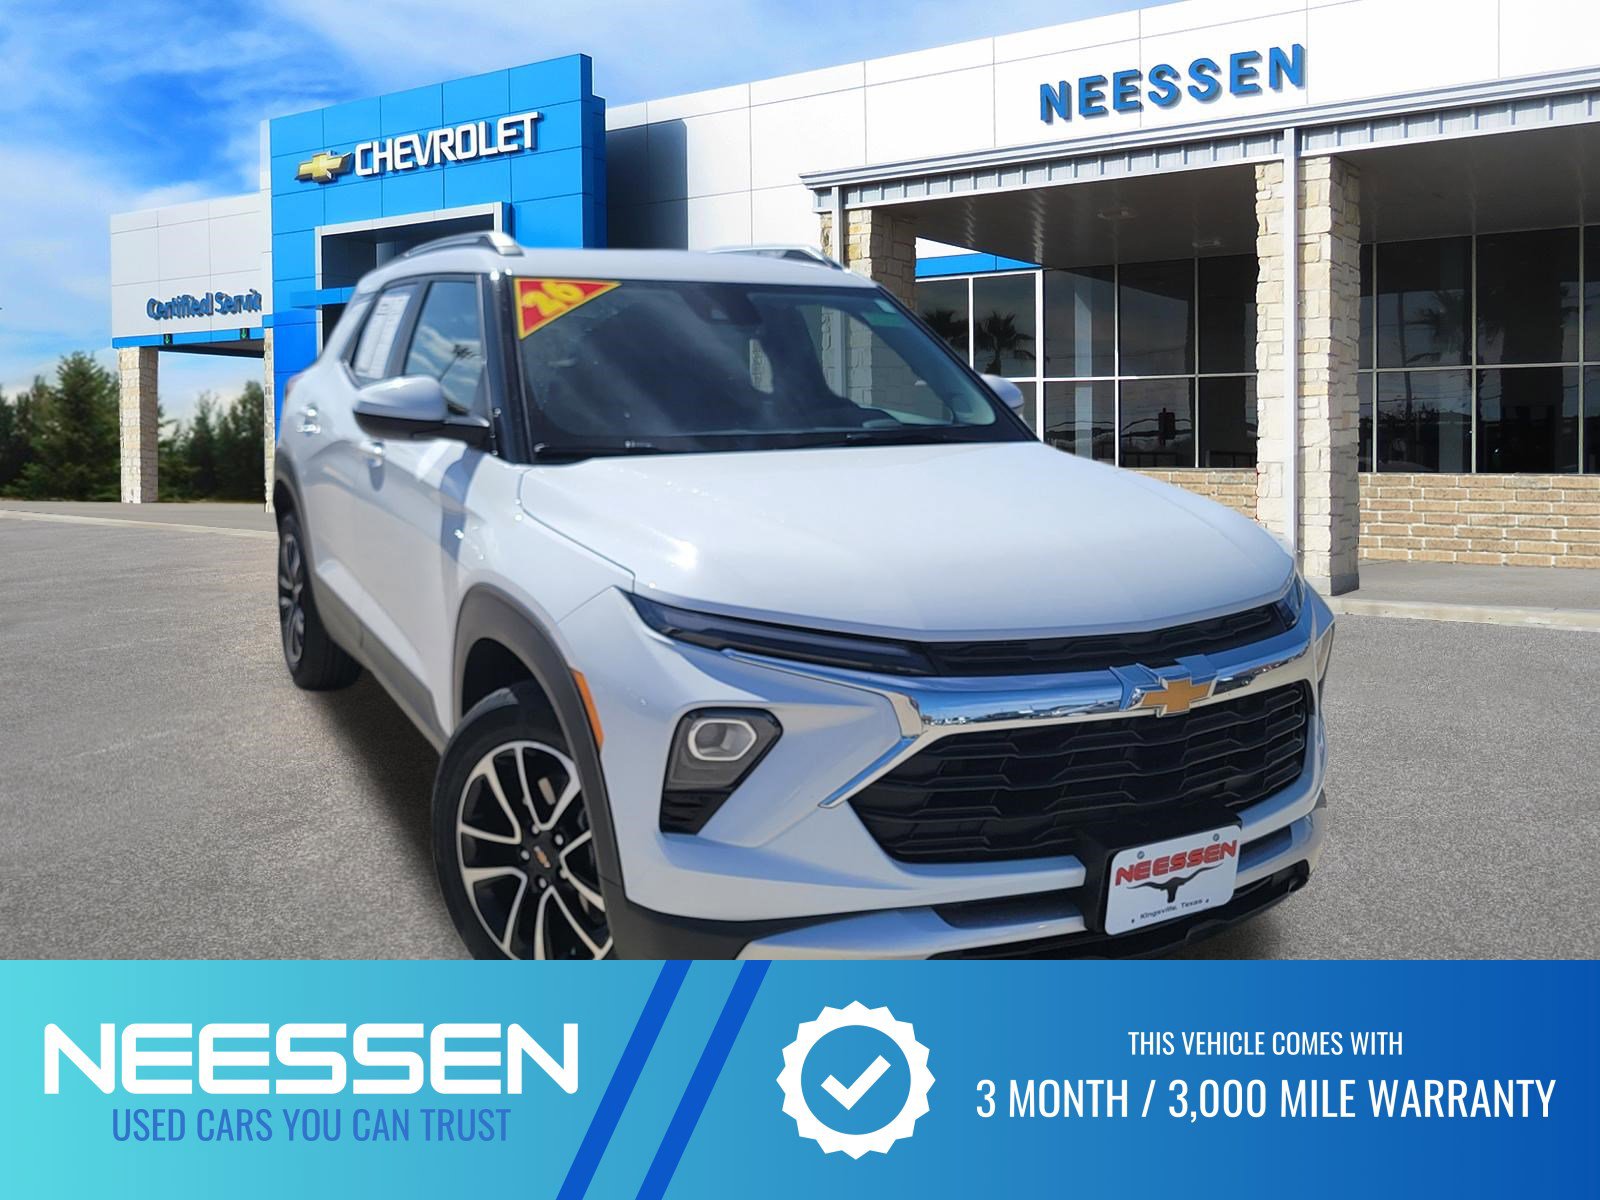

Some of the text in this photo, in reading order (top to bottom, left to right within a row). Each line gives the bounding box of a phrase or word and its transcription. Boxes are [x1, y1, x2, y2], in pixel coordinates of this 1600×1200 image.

[1040, 43, 1306, 123] NEESSEN
[355, 111, 543, 177] CHEVROLET
[146, 292, 214, 320] Certified
[522, 281, 584, 318] 26
[1115, 839, 1237, 886] NEESSEN
[1181, 898, 1203, 909] Texas
